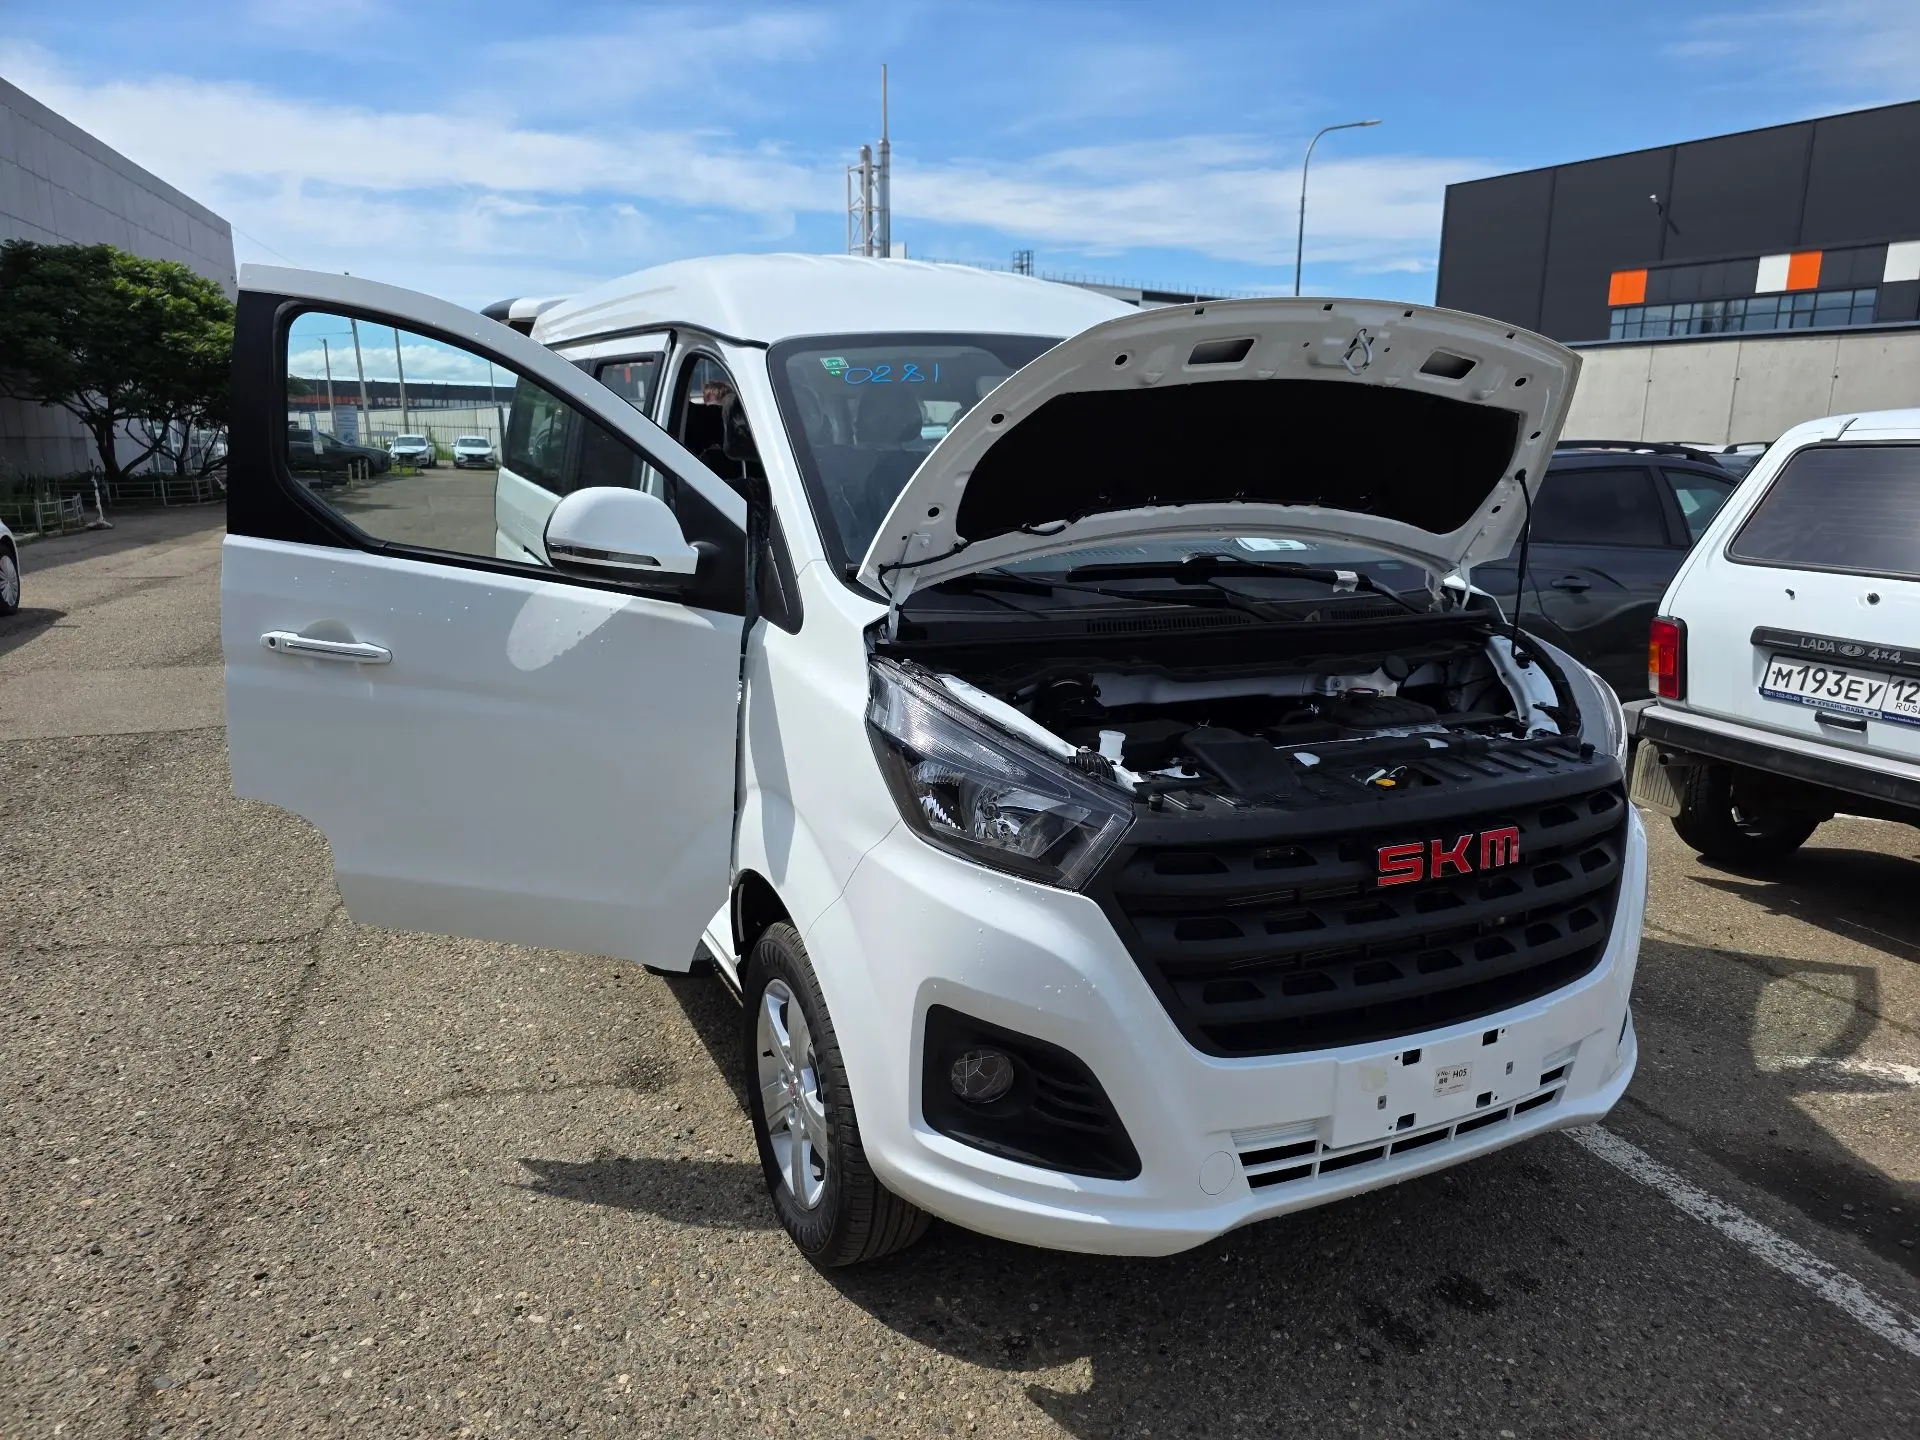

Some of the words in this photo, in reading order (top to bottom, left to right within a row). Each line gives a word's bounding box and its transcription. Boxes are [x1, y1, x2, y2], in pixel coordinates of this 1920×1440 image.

[844, 363, 939, 385] 0281
[1800, 637, 1836, 653] LADA
[1895, 702, 1918, 714] RUS
[1378, 826, 1520, 887] SKM
